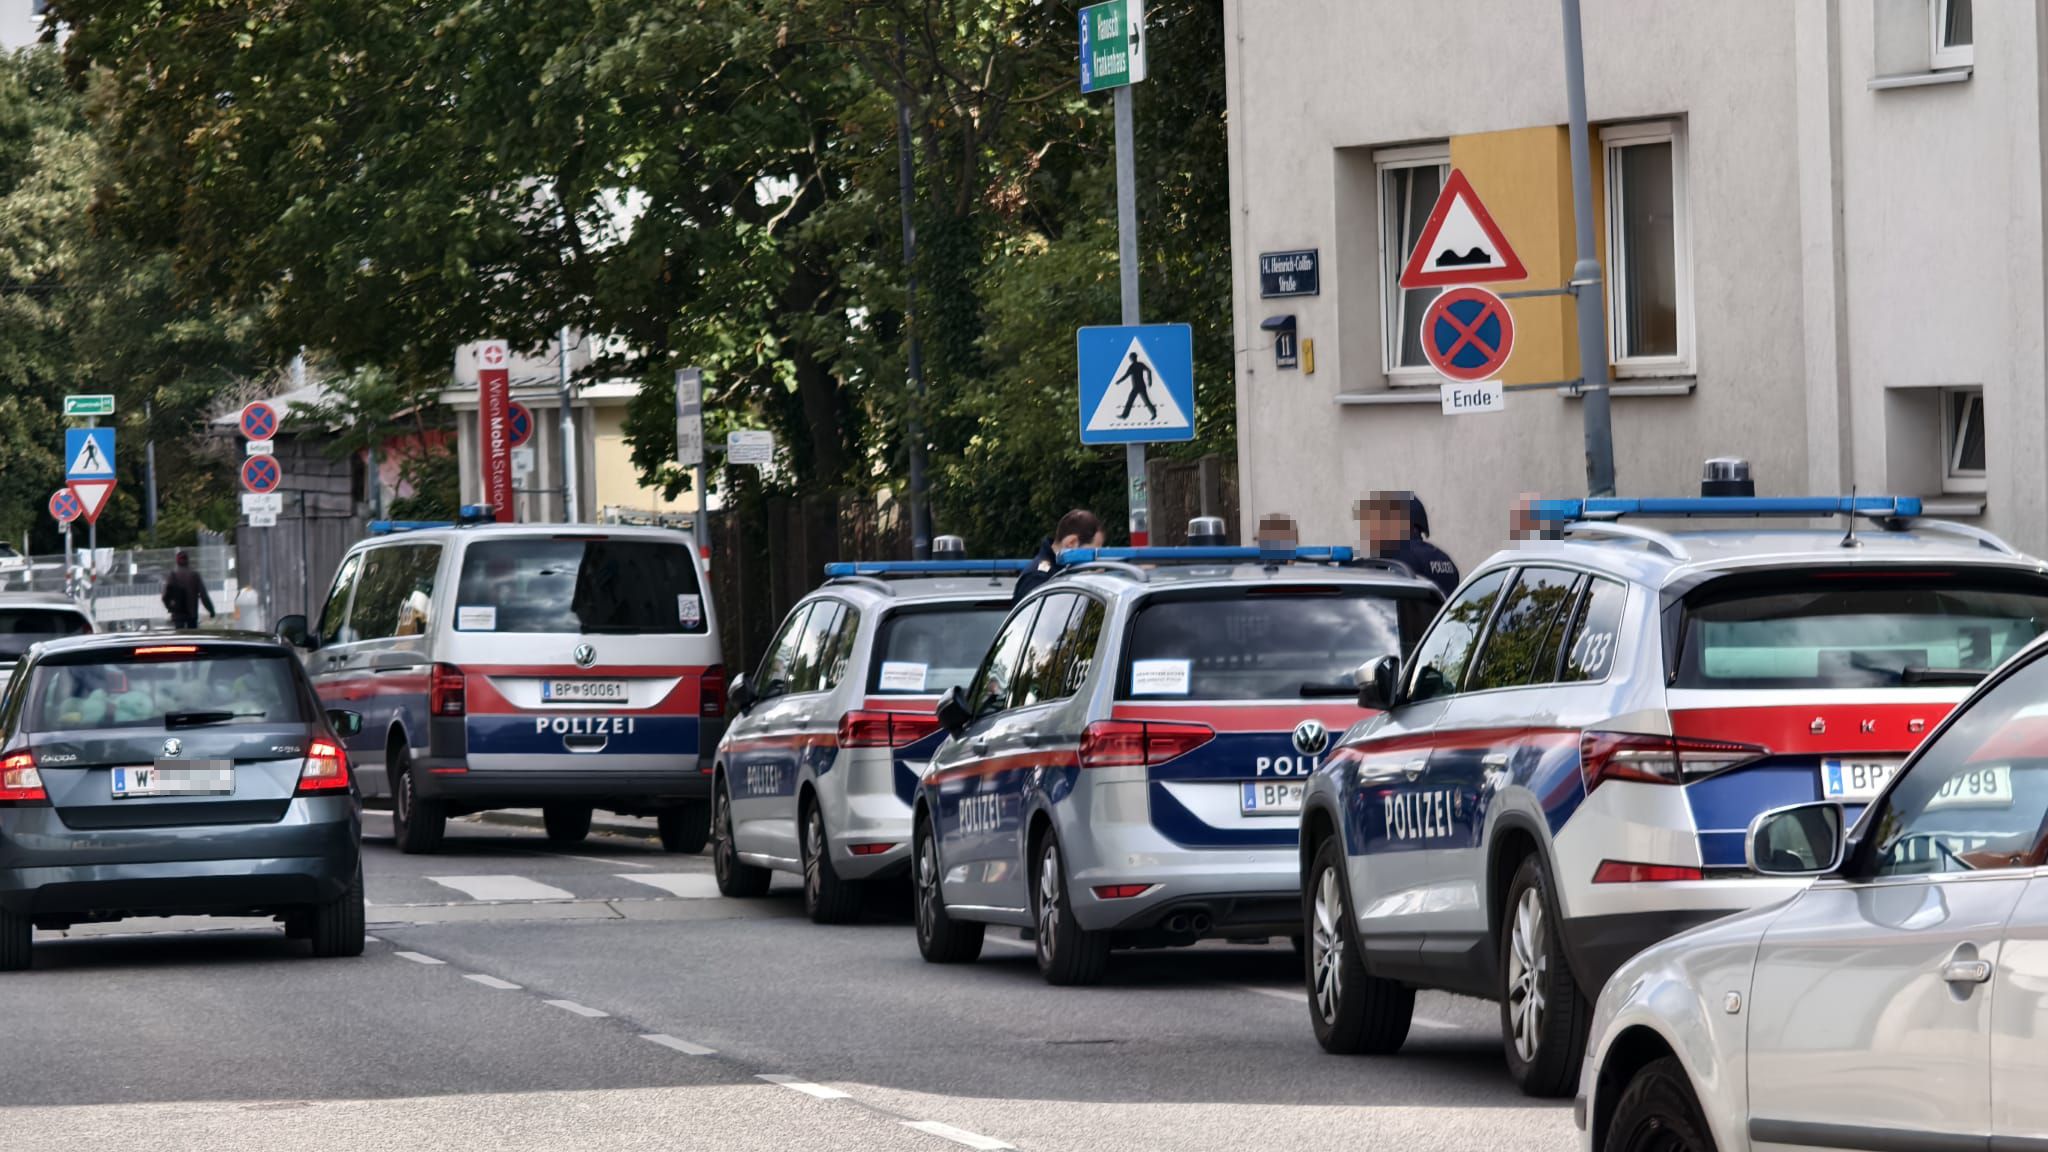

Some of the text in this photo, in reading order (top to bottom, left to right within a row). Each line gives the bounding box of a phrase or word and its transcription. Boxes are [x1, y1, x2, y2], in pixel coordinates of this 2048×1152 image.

[1093, 46, 1127, 78] Krankenhaus
[1278, 275, 1297, 292] Straße
[1281, 335, 1290, 356] 11
[1453, 389, 1491, 408] Ende
[489, 377, 506, 459] WienMobil
[1580, 632, 1612, 673] 133
[555, 683, 621, 697] BP 90061
[536, 717, 635, 735] POLIZEI
[135, 770, 148, 788] W
[1850, 763, 1883, 790] BP
[1263, 784, 1289, 806] BP
[958, 792, 1001, 833] POLIZEI
[1384, 789, 1453, 841] POLIZEI
